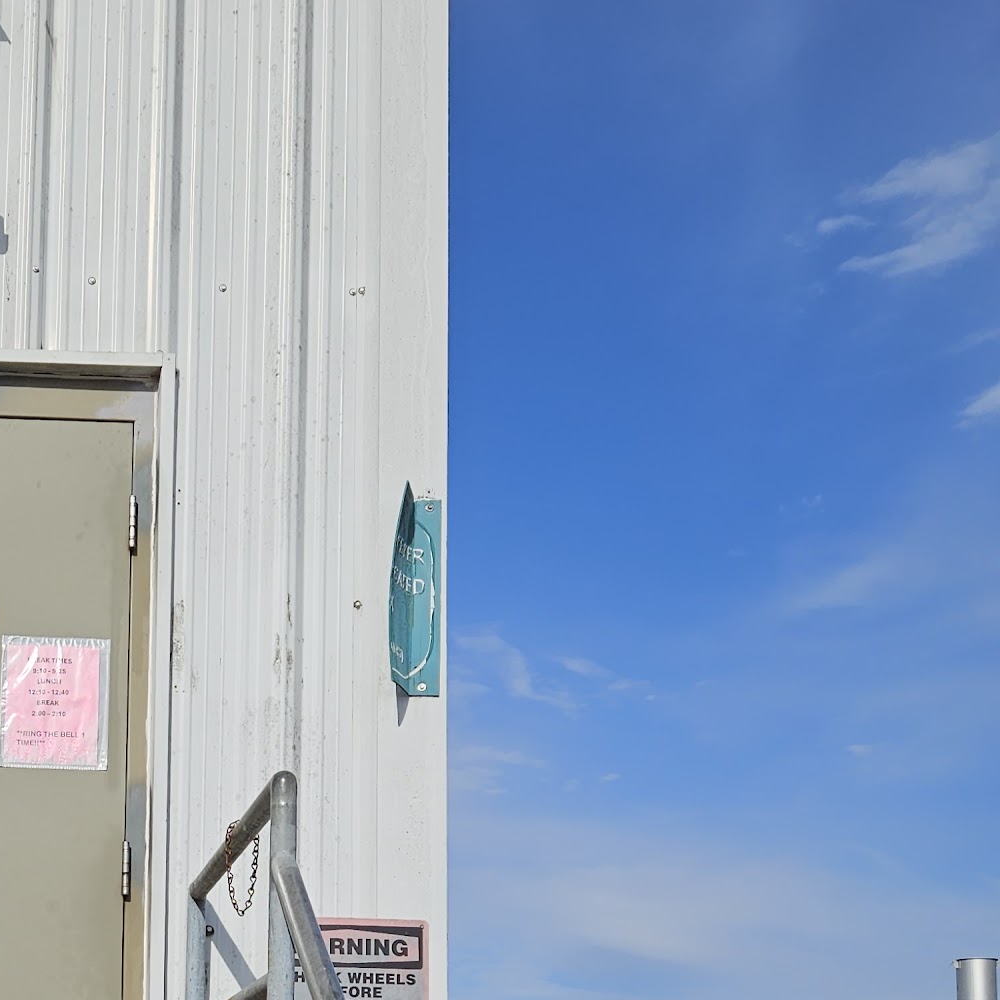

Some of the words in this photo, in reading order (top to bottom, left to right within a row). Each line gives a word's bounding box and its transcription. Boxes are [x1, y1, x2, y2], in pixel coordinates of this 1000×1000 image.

[43, 730, 59, 738] THE
[329, 938, 409, 957] RNING
[347, 973, 416, 985] WHEELS
[341, 986, 382, 998] FORE
